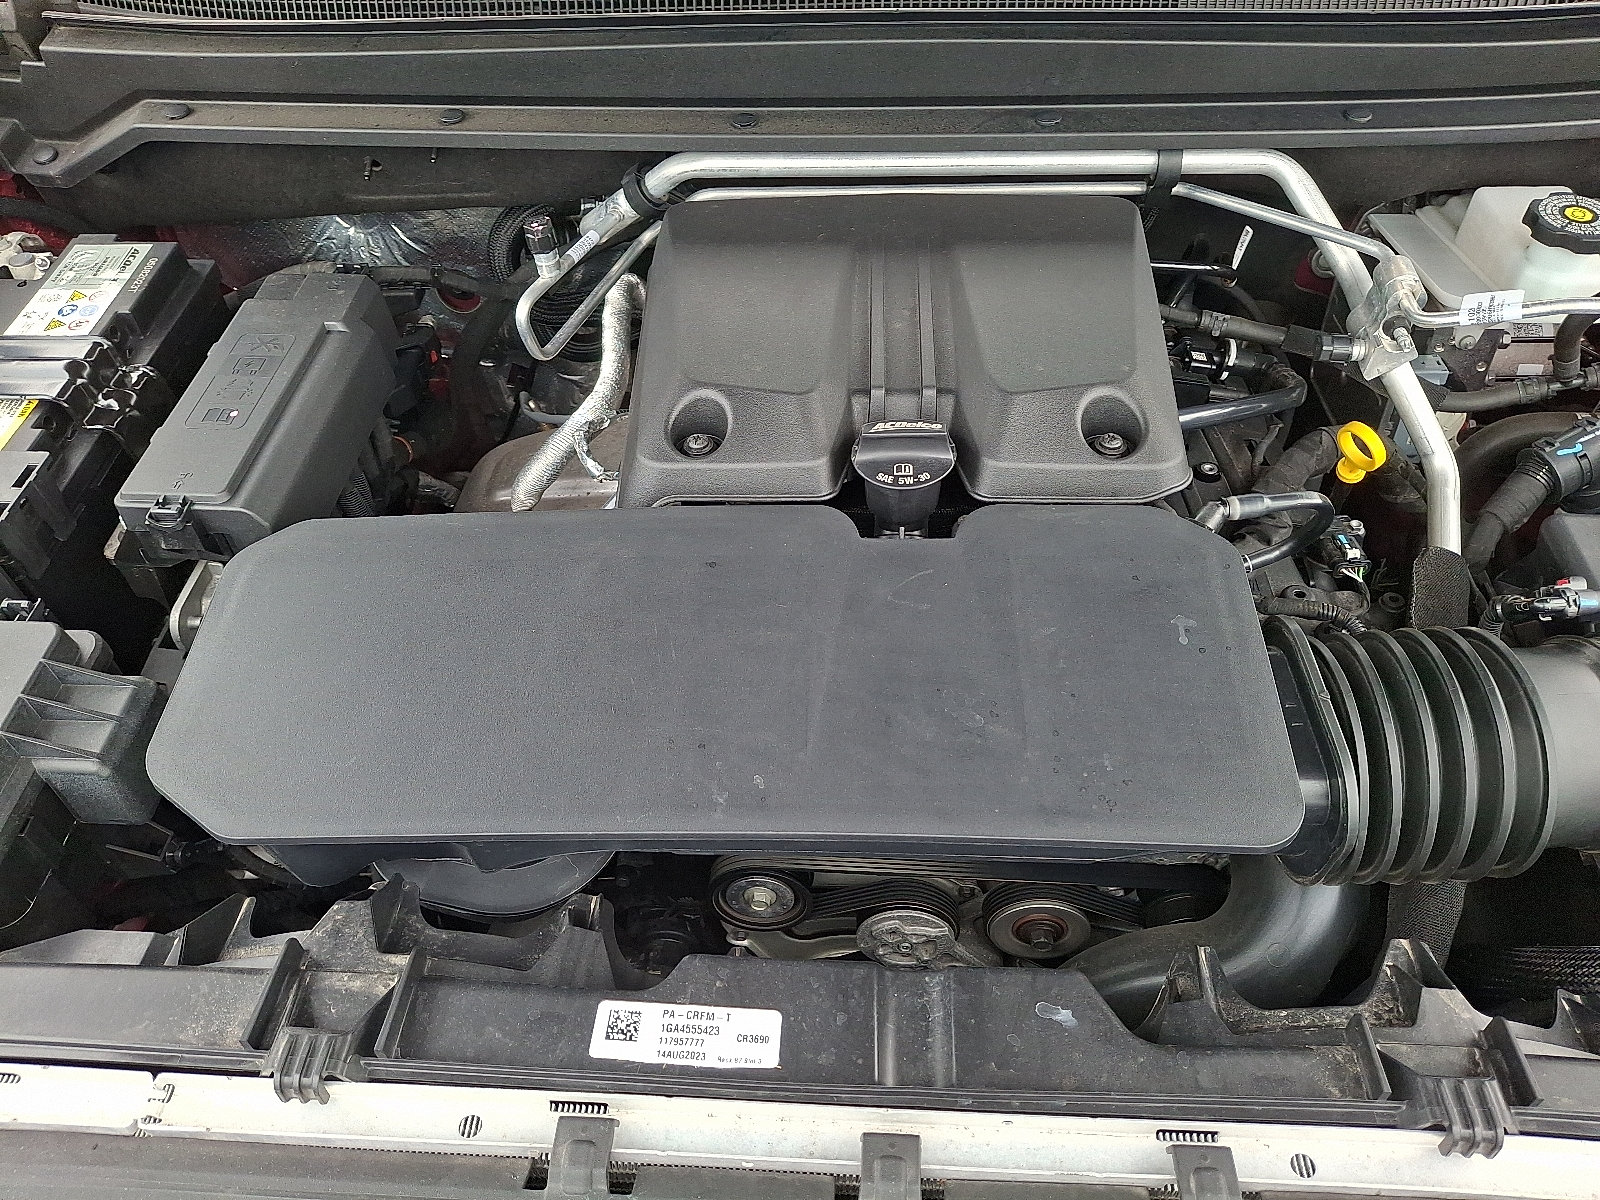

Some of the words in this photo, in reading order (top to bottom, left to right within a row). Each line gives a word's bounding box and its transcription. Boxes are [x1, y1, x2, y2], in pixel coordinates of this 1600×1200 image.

[871, 421, 943, 431] ACDelco
[876, 472, 895, 484] SAE
[898, 472, 931, 485] 5W-30
[661, 1023, 720, 1036] 1GA4555423
[659, 1037, 705, 1048] 117957777
[736, 1033, 770, 1044] CR3690
[657, 1050, 706, 1061] 14AUG2023
